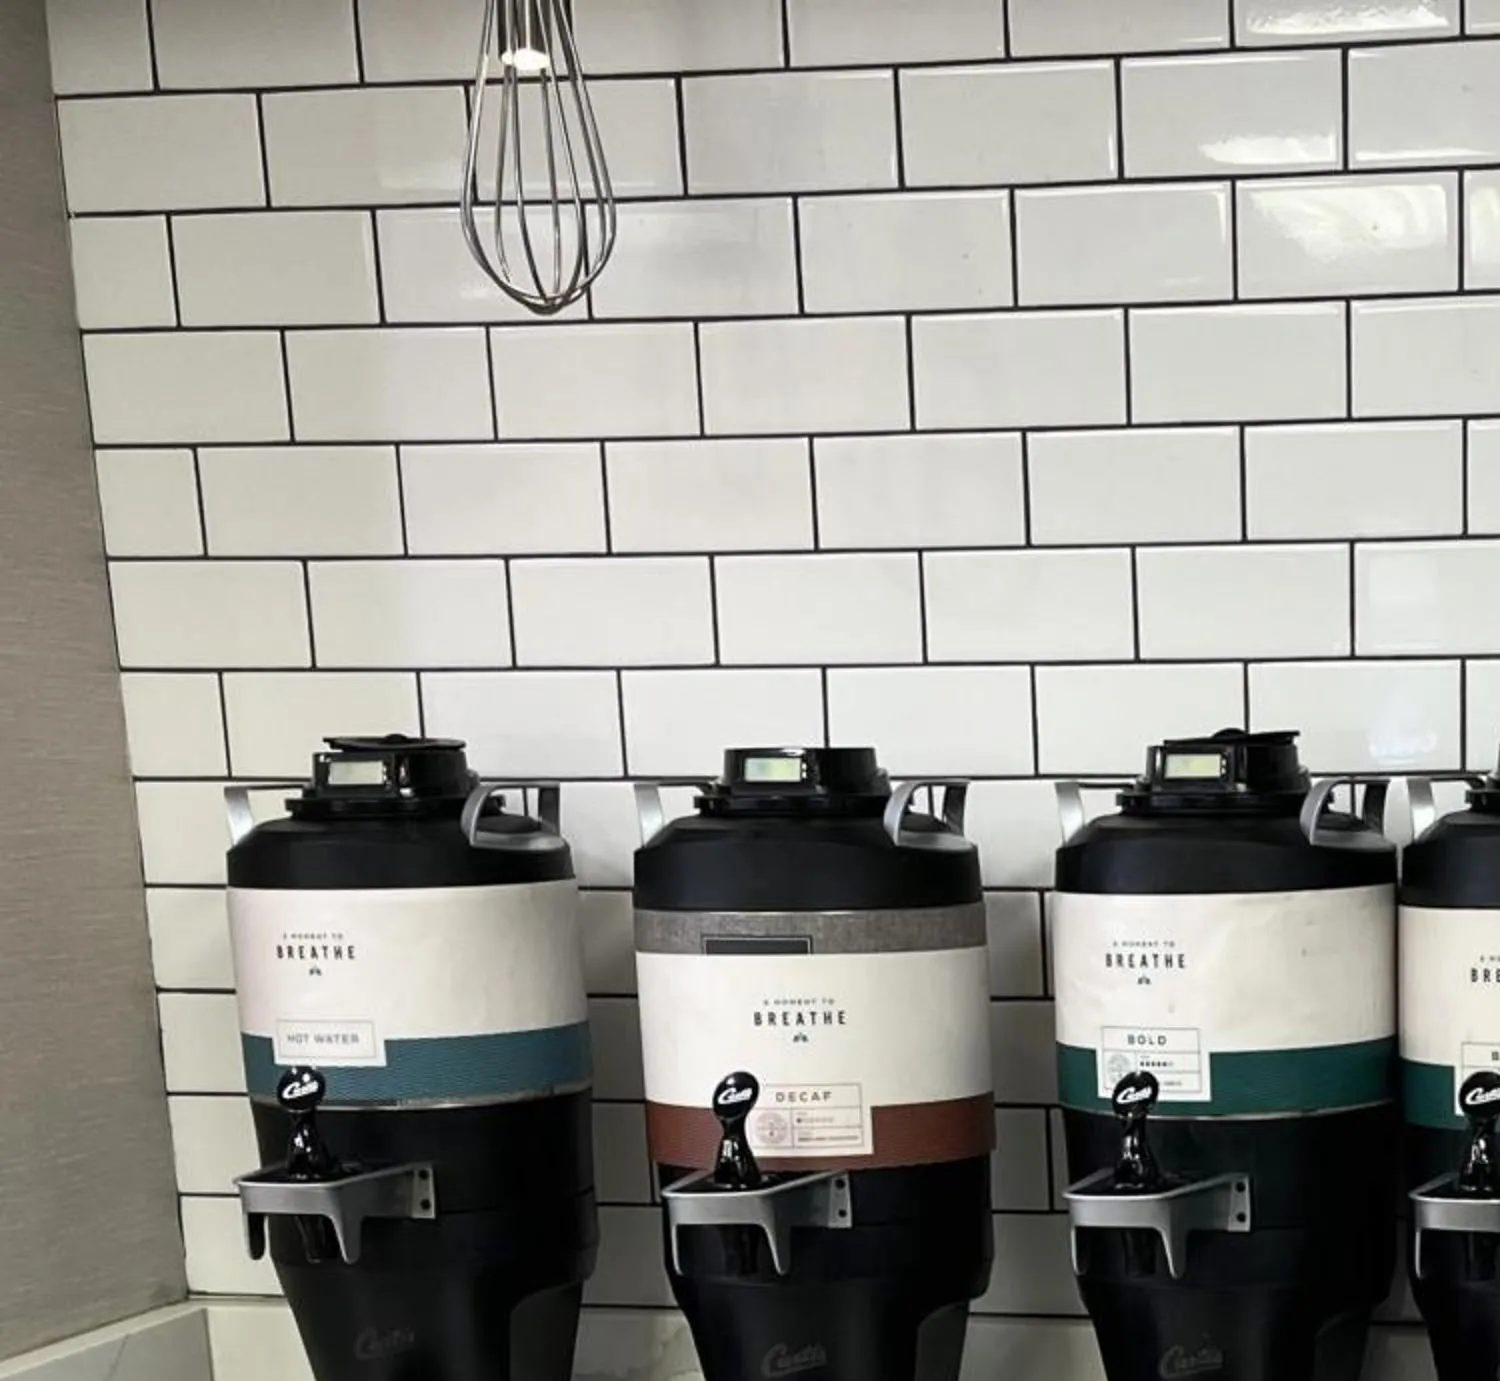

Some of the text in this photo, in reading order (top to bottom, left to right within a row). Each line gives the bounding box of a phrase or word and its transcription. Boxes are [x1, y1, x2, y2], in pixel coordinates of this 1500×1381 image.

[276, 945, 356, 960] BREATHE
[1105, 953, 1186, 968] BREATHE
[753, 1010, 847, 1026] BREATHE
[287, 1033, 359, 1045] HOT WATER
[1126, 1034, 1168, 1046] BOLD
[775, 1091, 833, 1103] DECAF
